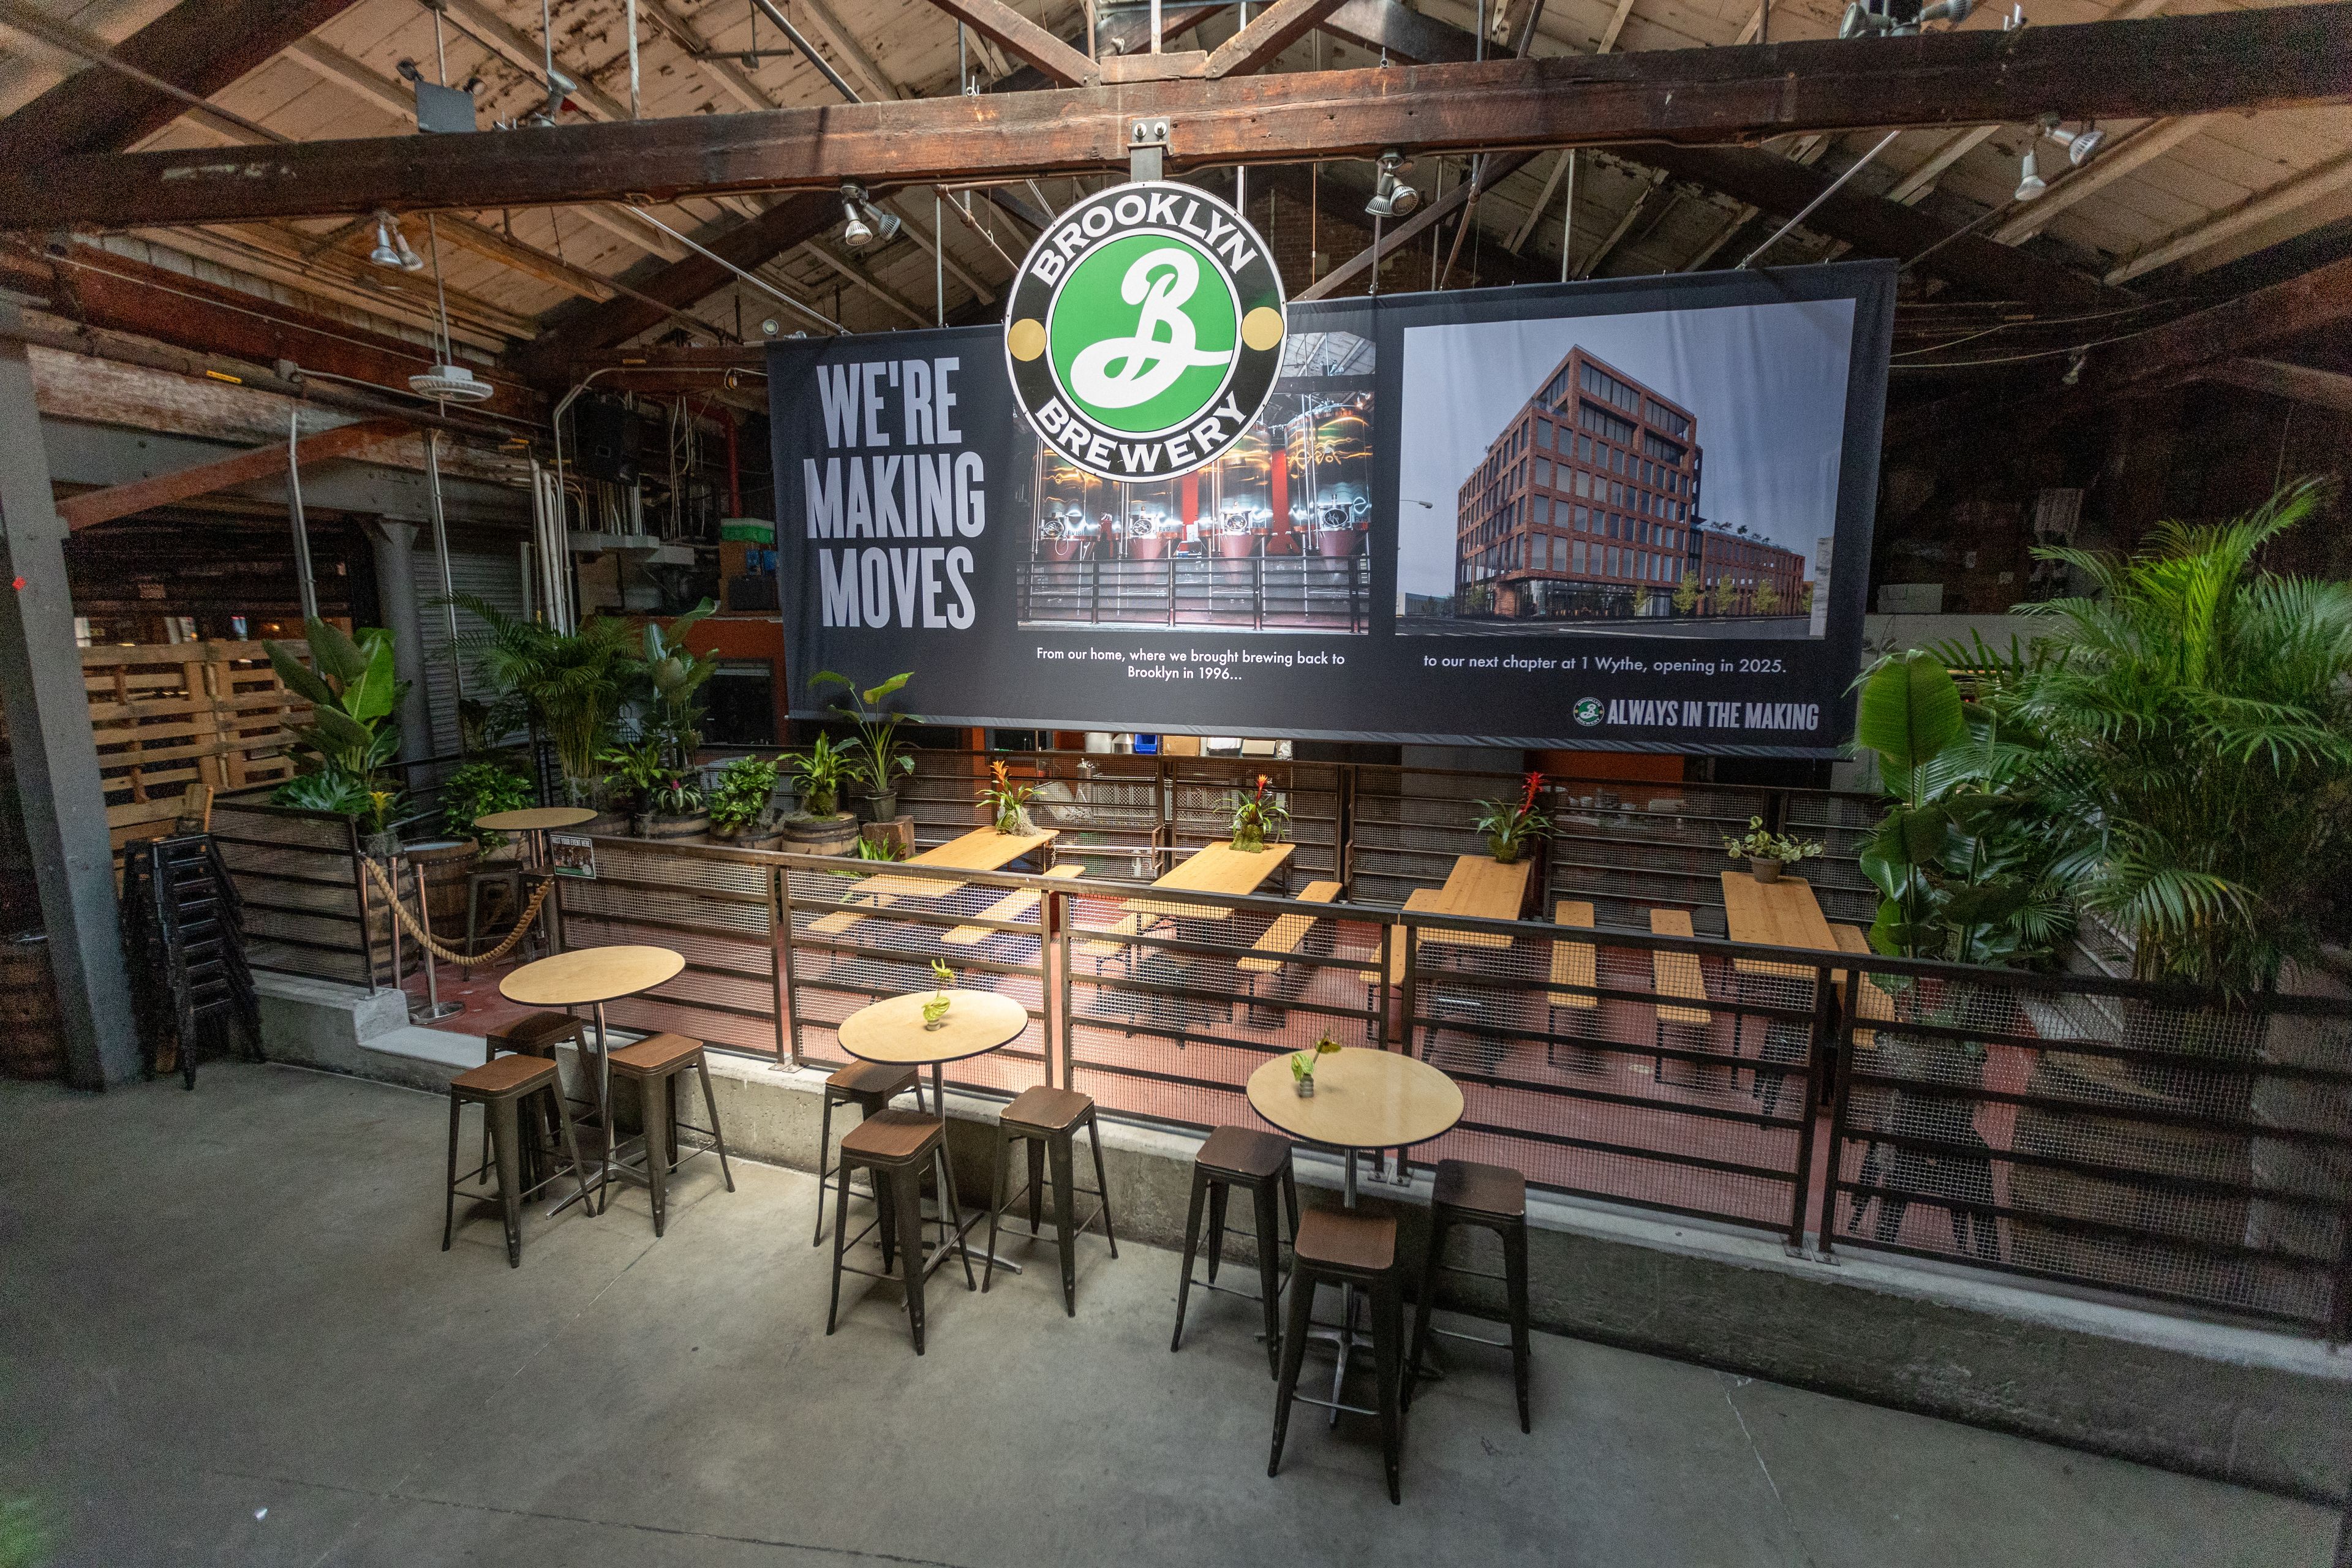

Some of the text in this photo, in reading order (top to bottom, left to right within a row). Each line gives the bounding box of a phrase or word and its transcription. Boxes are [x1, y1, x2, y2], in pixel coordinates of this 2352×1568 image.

[1030, 192, 1257, 287] BROOKLYN
[816, 357, 962, 448] WE'RE
[1035, 390, 1247, 472] BREWERY
[804, 451, 985, 538] MAKING
[820, 546, 975, 630] MOVES
[1037, 647, 1345, 667] From our home, where we brought brewing back to
[1423, 654, 1787, 675] to our next chapter at 1 Wythe, opening in 2025.
[1128, 665, 1242, 682] Brooklyn in 1996...
[1577, 698, 1602, 707] BROOKLYN
[1607, 699, 1820, 730] ALWAYS IN THE MAKING
[1577, 717, 1600, 725] BREWERY
